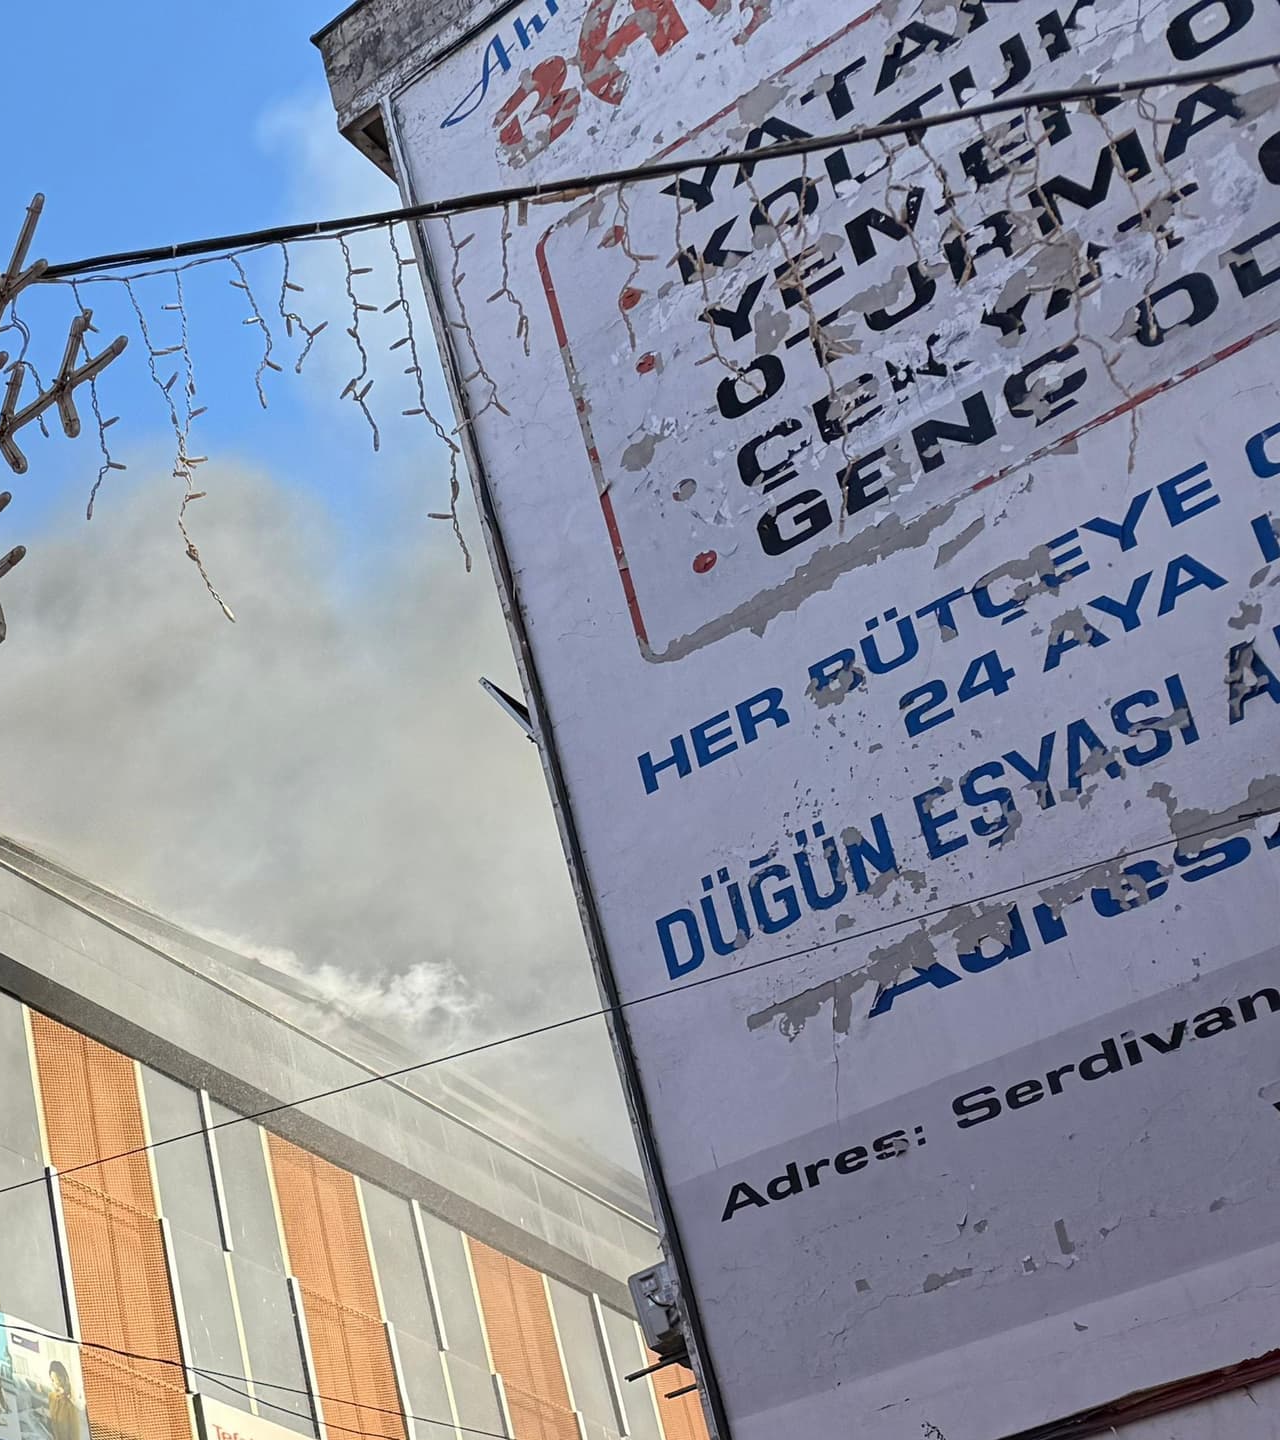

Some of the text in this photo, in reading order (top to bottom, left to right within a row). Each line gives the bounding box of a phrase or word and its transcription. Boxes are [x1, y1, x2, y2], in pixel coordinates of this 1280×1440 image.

[898, 554, 1229, 738] 24 AYA
[638, 686, 791, 795] HER
[655, 813, 899, 981] DÜĞÜN
[913, 673, 1200, 860] EŞYASI
[720, 1124, 927, 1222] Adres:
